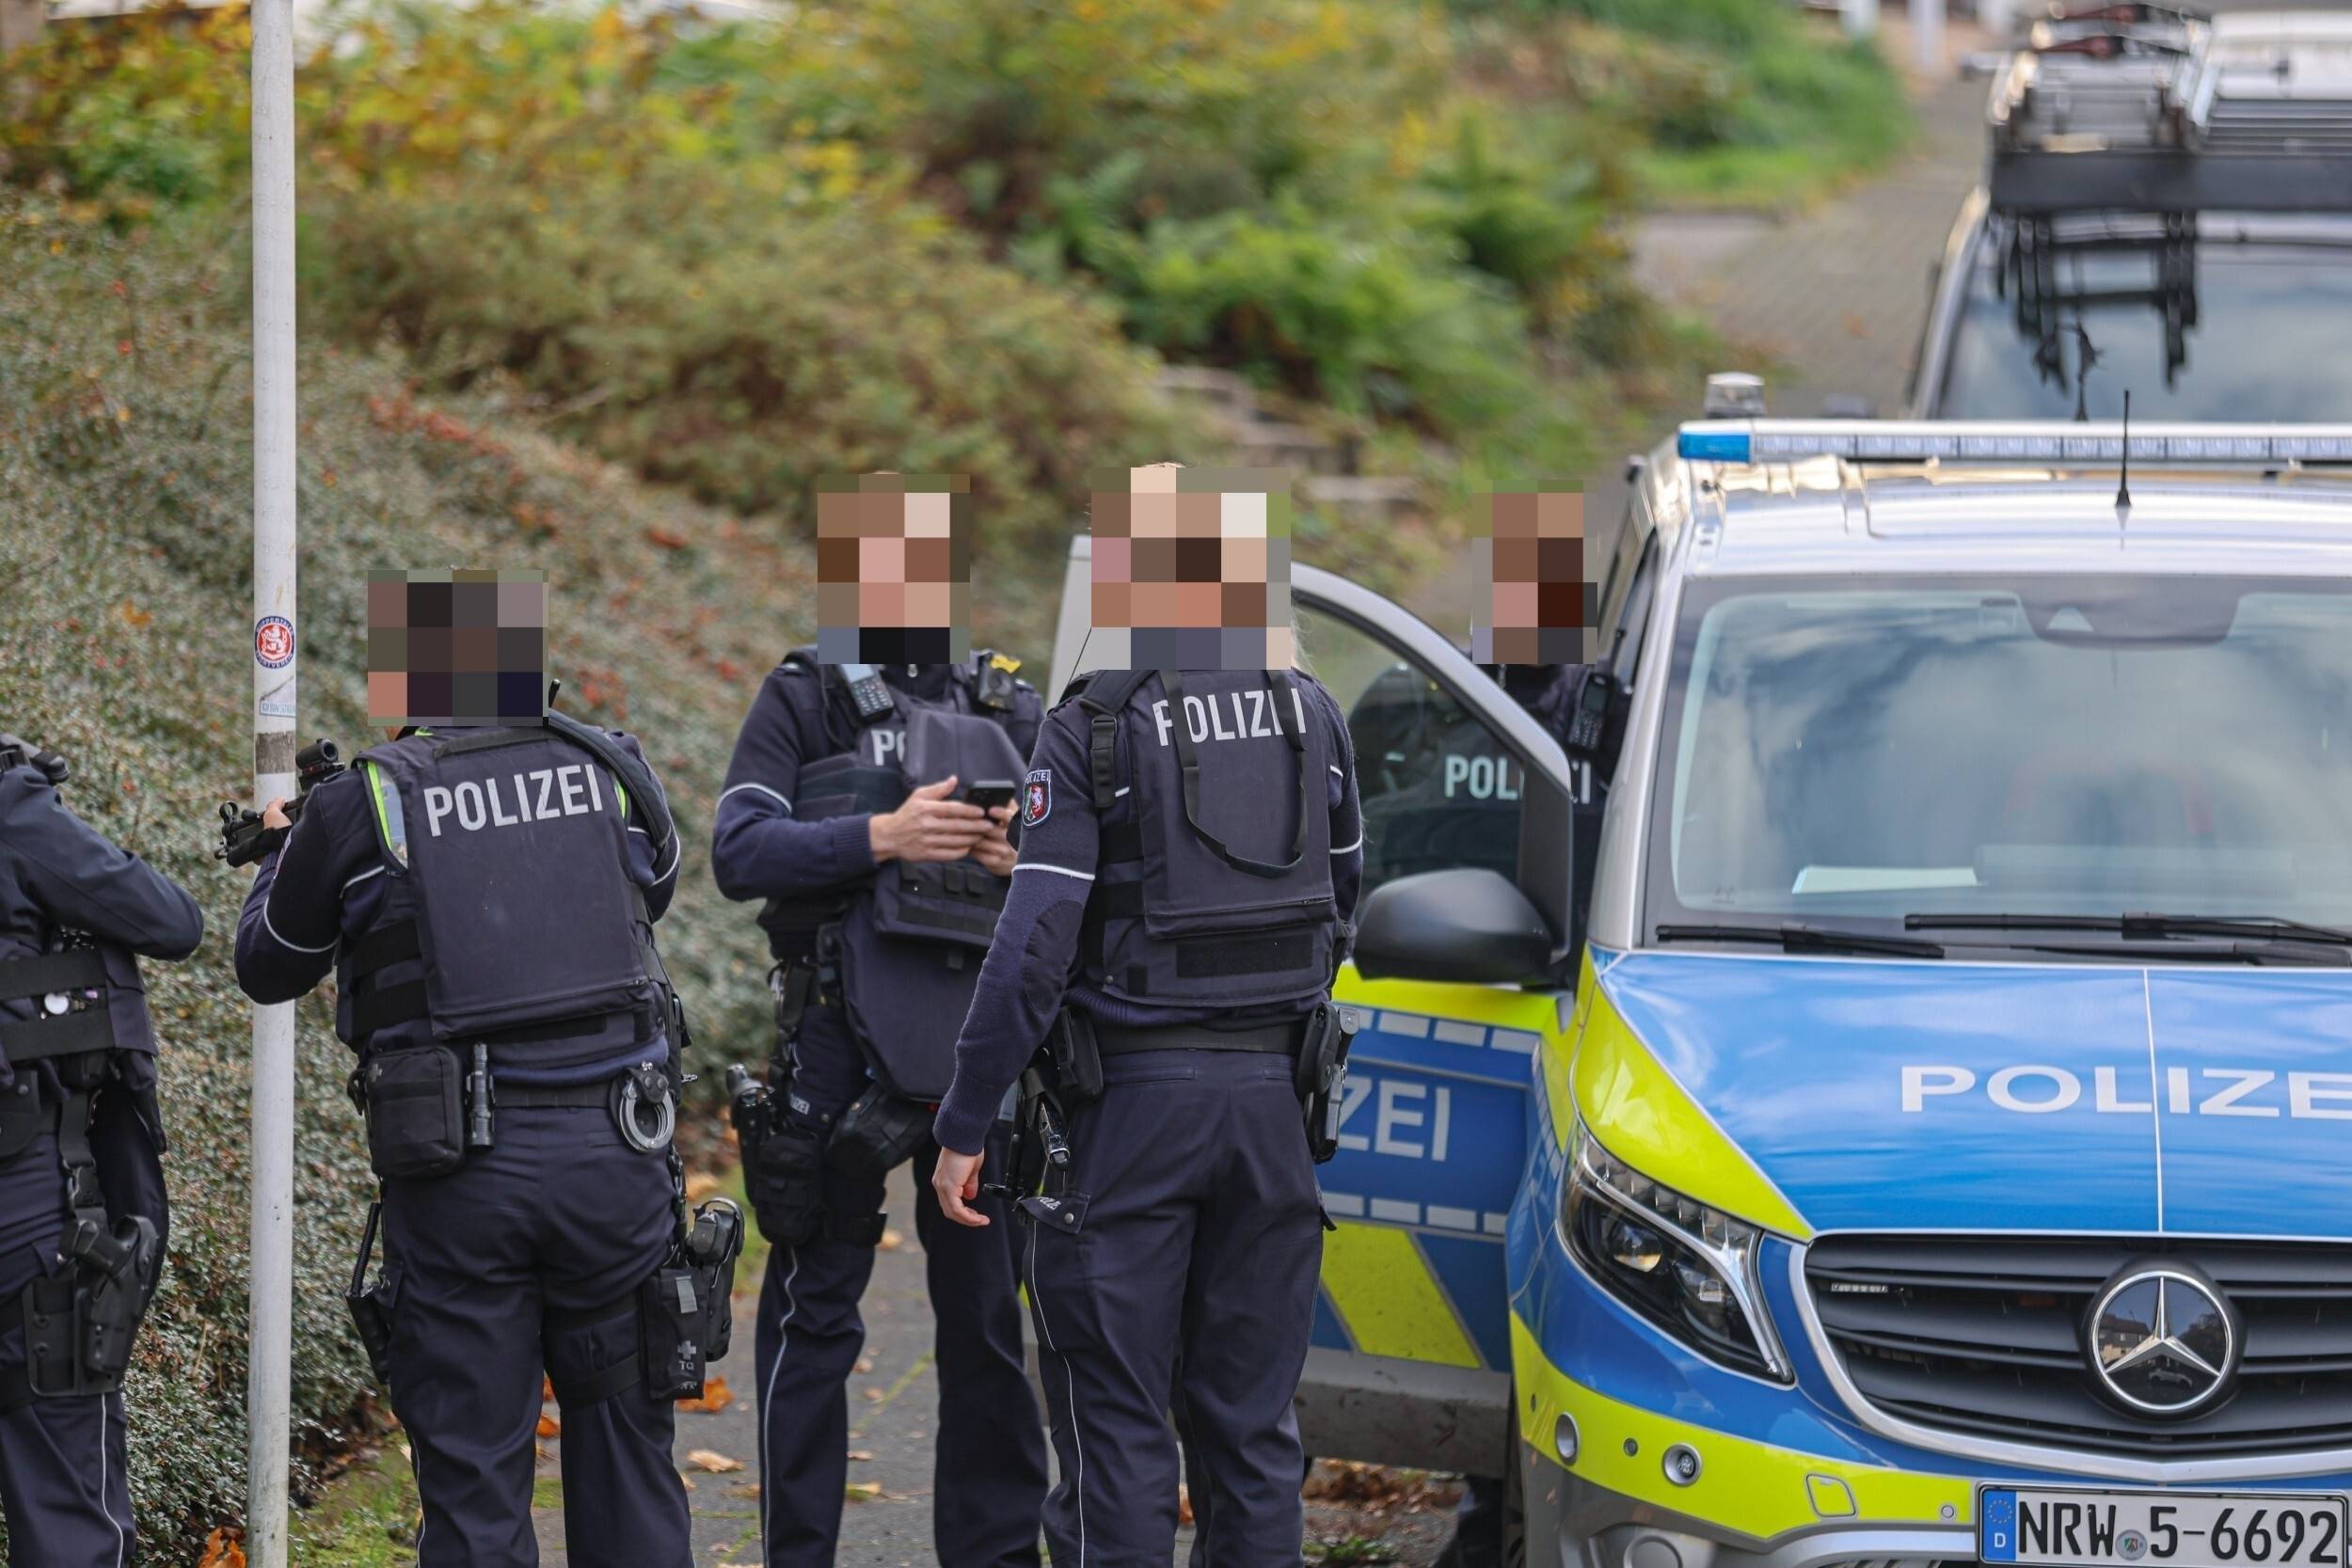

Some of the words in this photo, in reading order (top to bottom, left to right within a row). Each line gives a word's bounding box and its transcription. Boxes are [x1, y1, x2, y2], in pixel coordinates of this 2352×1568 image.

[423, 764, 603, 837] POLIZEI
[1445, 754, 1591, 804] POLI
[1901, 1065, 2352, 1120] POLIZE
[1994, 1532, 2006, 1548] D
[2018, 1501, 2117, 1557] NRW
[2150, 1505, 2338, 1564] 5-6692
